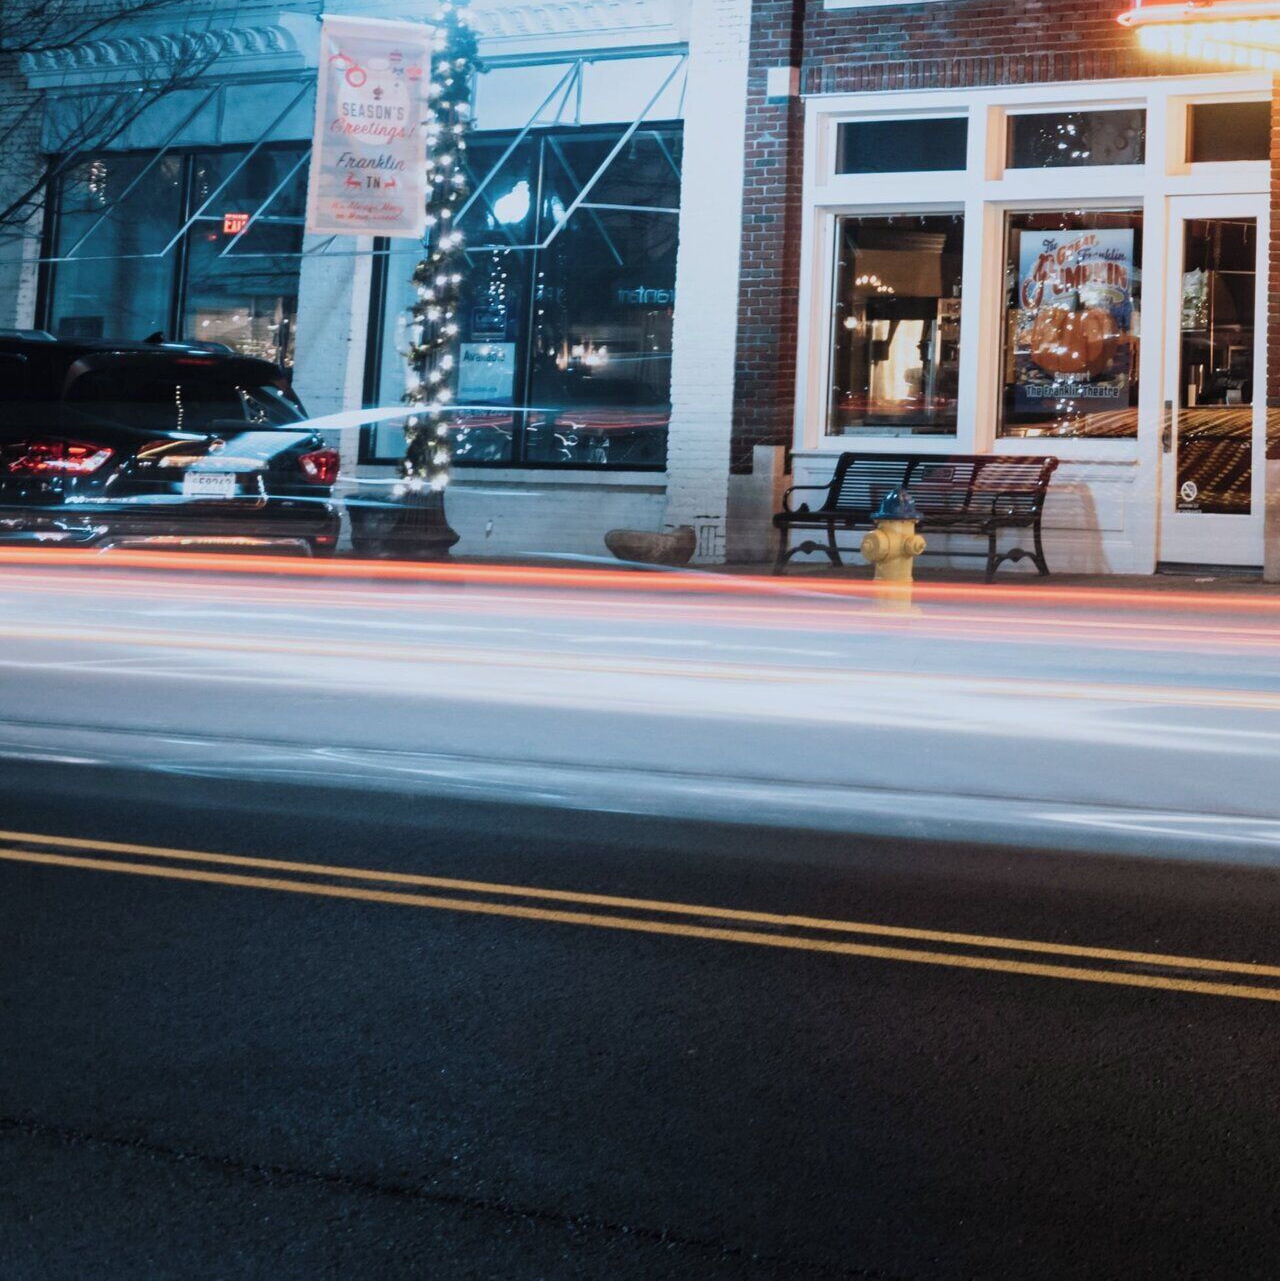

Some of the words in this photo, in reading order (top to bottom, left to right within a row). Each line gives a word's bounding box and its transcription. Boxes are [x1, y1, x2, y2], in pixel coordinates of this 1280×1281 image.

[342, 101, 405, 120] SEASON'S
[330, 117, 416, 144] Greetings!
[336, 151, 406, 171] Franklin
[366, 175, 381, 188] TN
[1026, 386, 1042, 397] The
[1044, 386, 1080, 397] Franklin
[1083, 386, 1120, 397] Theatre
